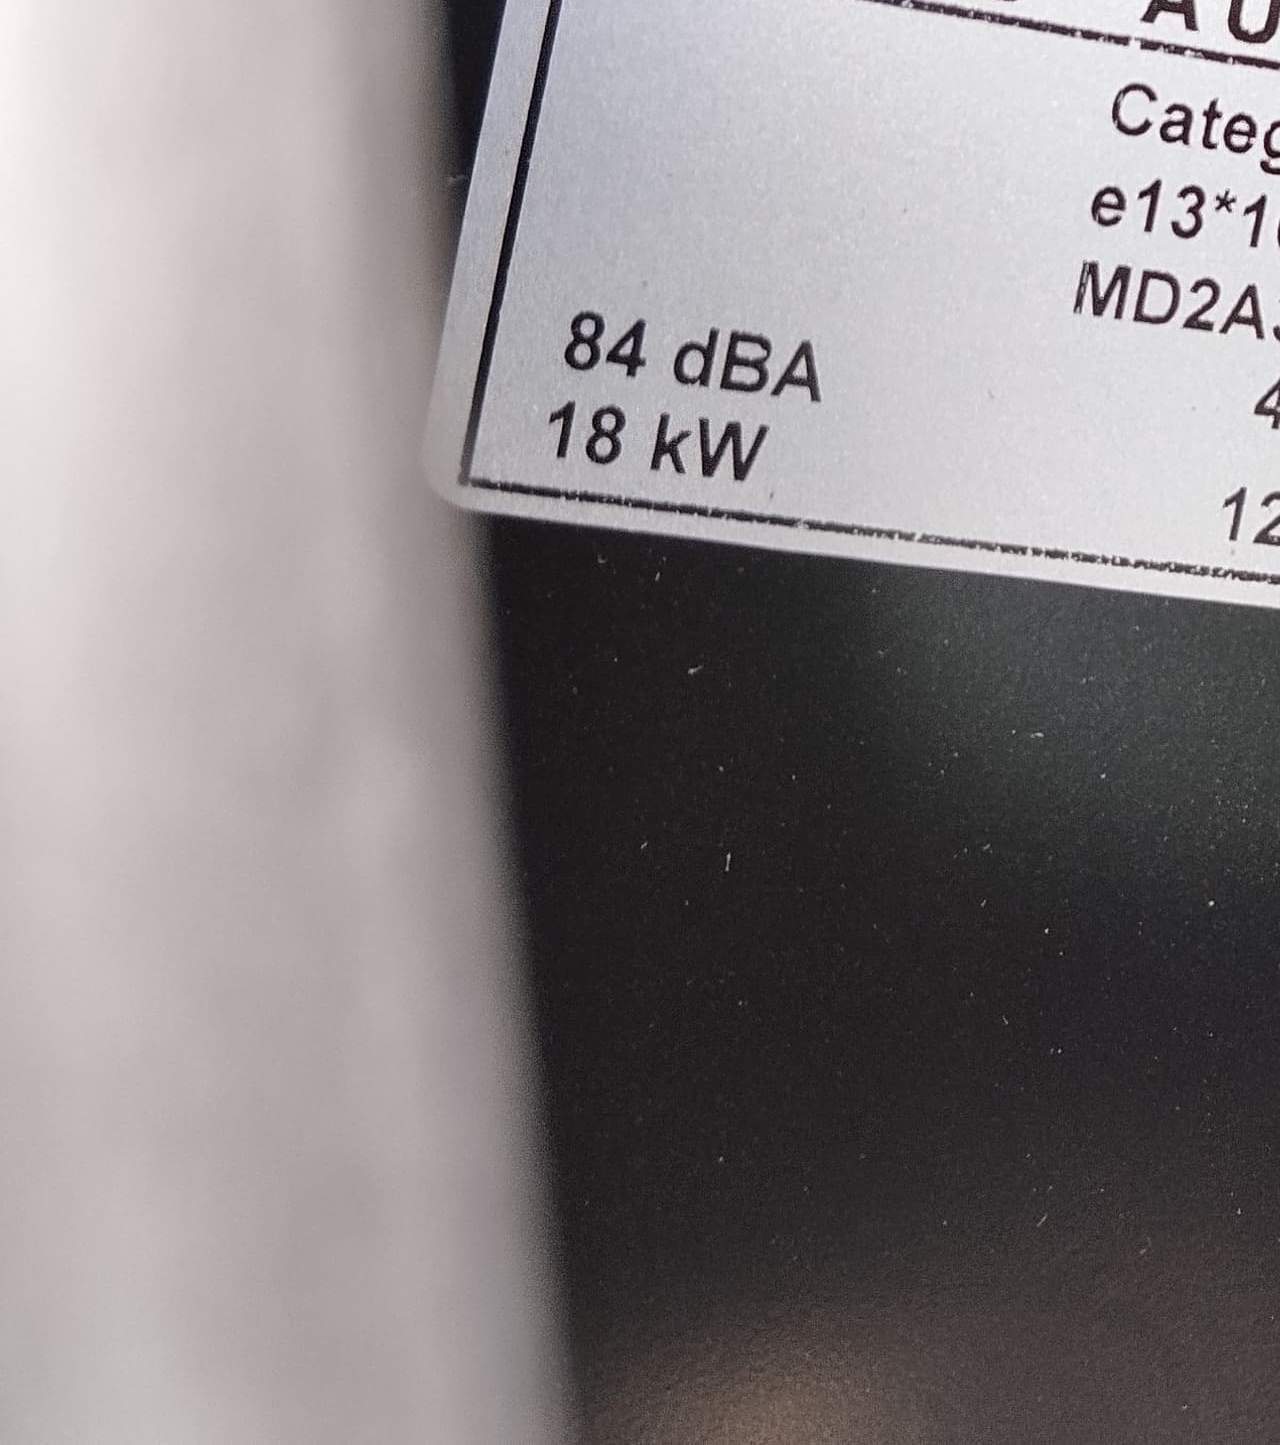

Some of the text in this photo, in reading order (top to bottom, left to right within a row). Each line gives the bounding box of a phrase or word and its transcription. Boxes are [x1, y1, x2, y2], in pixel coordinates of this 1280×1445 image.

[562, 310, 822, 403] 84 dBA
[547, 400, 770, 482] 18 kW
